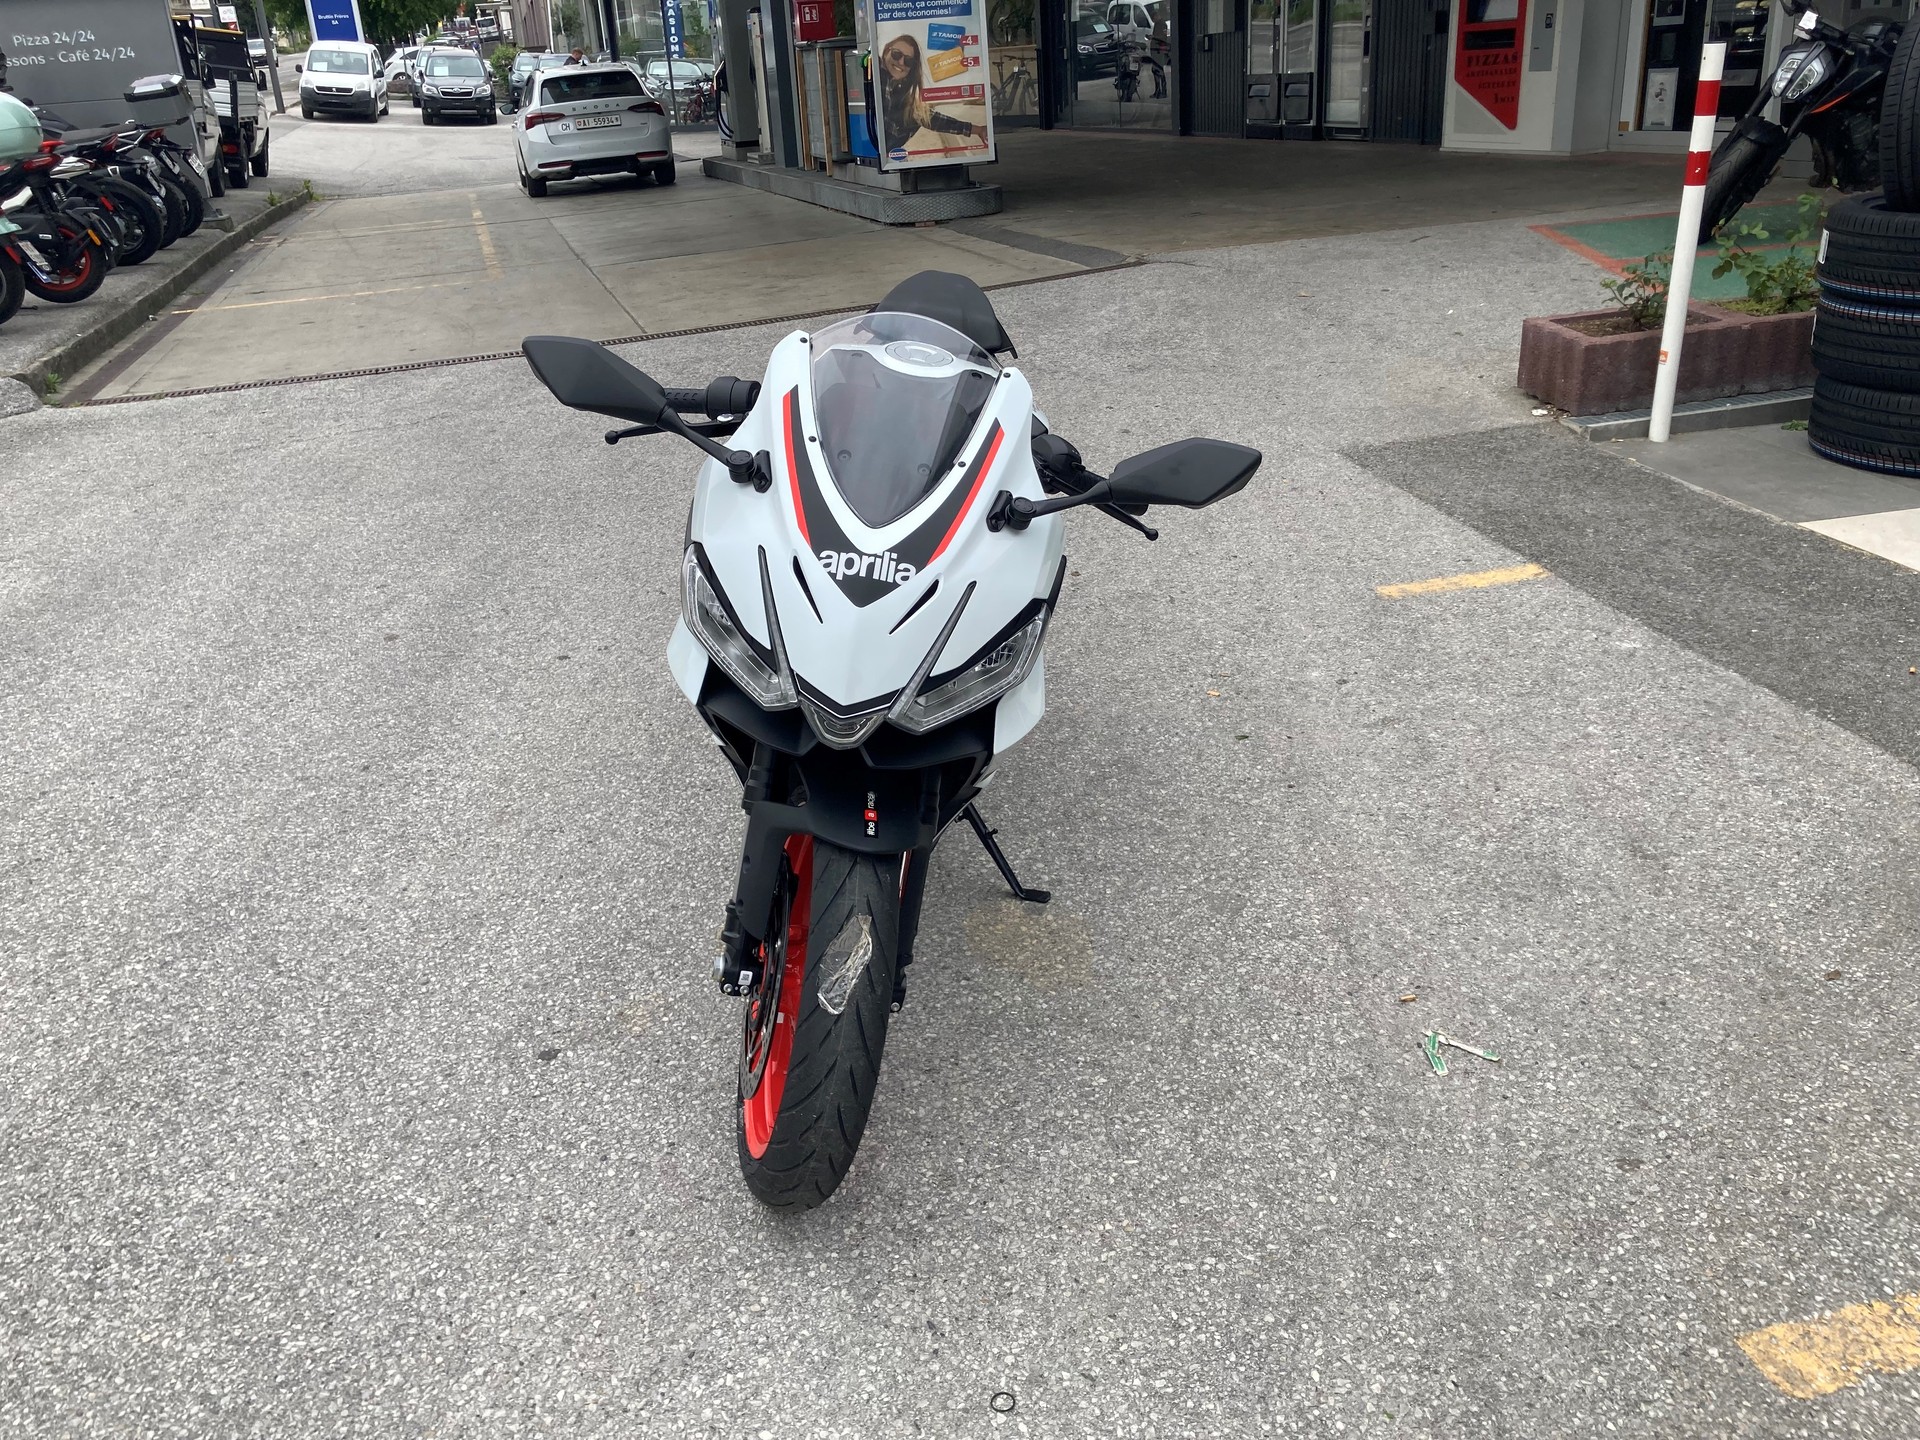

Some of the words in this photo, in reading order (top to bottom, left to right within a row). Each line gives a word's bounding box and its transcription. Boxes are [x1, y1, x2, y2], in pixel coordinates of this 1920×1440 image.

[877, 2, 915, 10] L'évasion,
[915, 1, 925, 9] ça
[878, 12, 891, 20] par
[907, 7, 952, 17] économies!
[13, 34, 51, 47] Pizza
[53, 30, 95, 46] 24/24
[58, 49, 90, 63] Café
[93, 46, 136, 62] 24/24
[1467, 52, 1518, 67] PIZZAS
[561, 122, 571, 132] CH
[593, 116, 614, 125] 55934
[819, 550, 917, 585] aprilia
